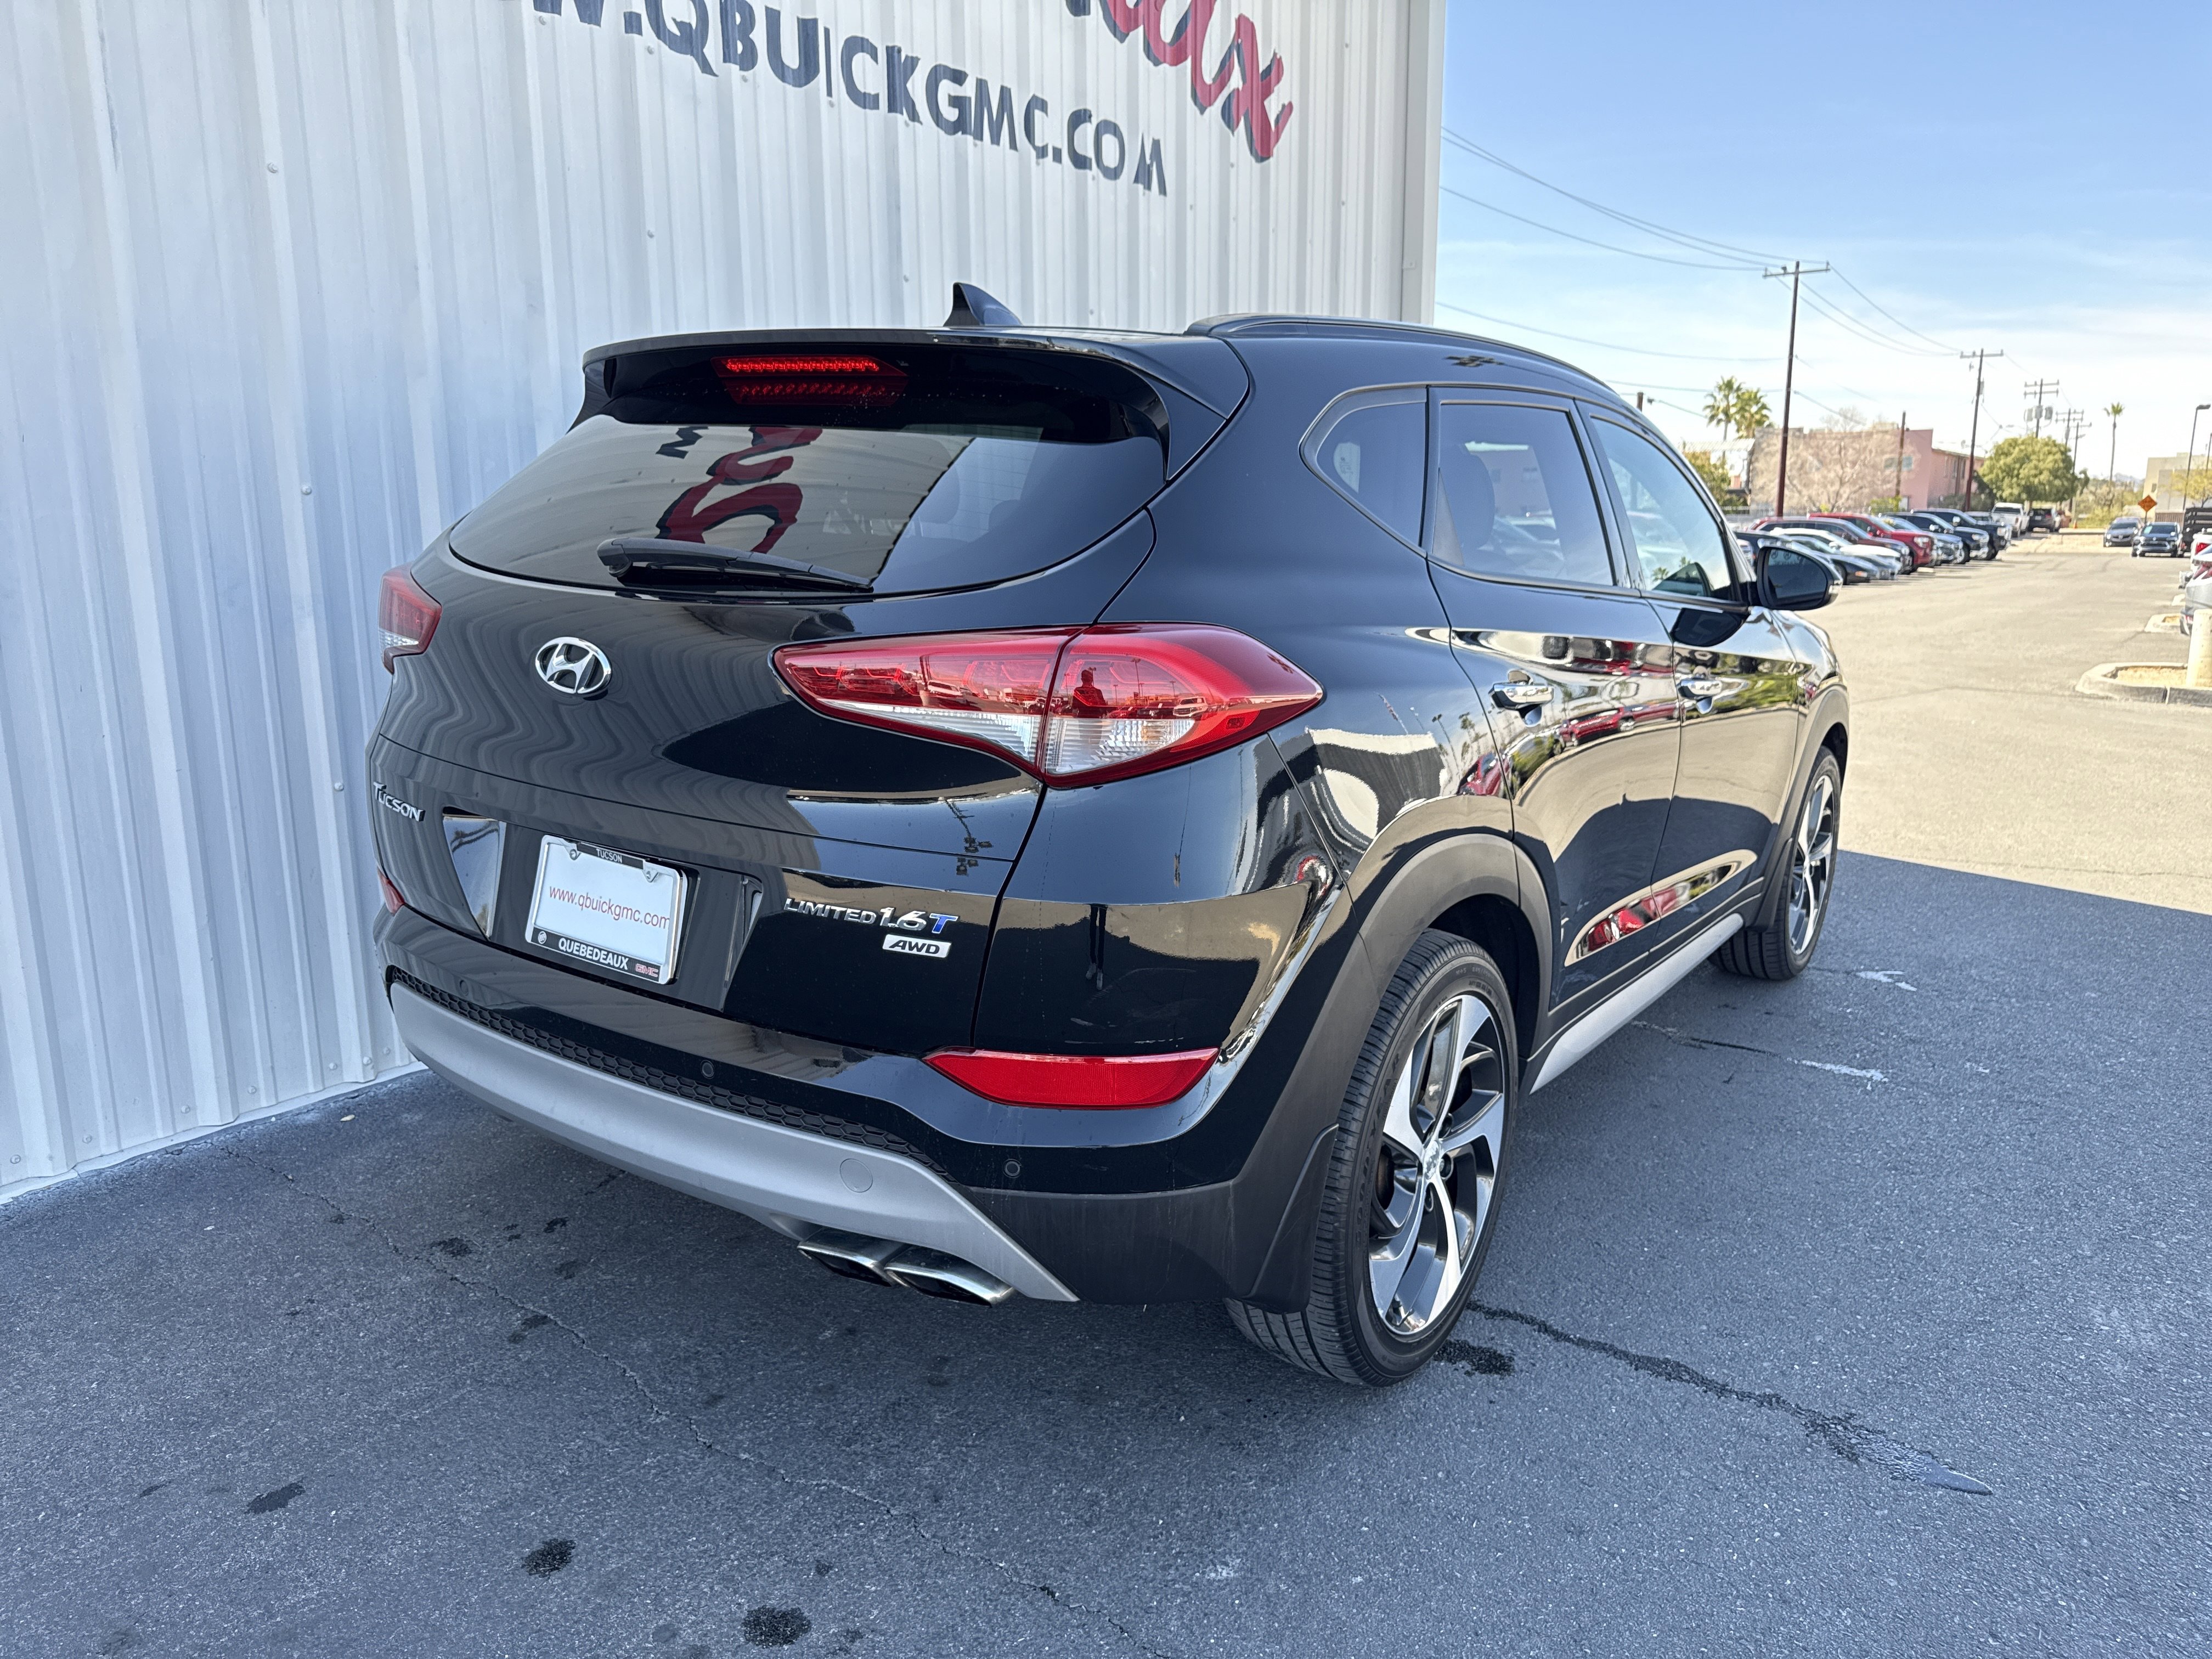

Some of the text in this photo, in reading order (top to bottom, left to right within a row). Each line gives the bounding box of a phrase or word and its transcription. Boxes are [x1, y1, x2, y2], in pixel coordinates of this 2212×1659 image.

[373, 781, 425, 822] TUCSON
[596, 849, 623, 864] TUCSON
[549, 886, 670, 930] www.qbuickgmc.com
[783, 898, 877, 924] LIMITED
[558, 938, 658, 978] QUEBEDEAUX GMC
[889, 940, 940, 955] AWD
